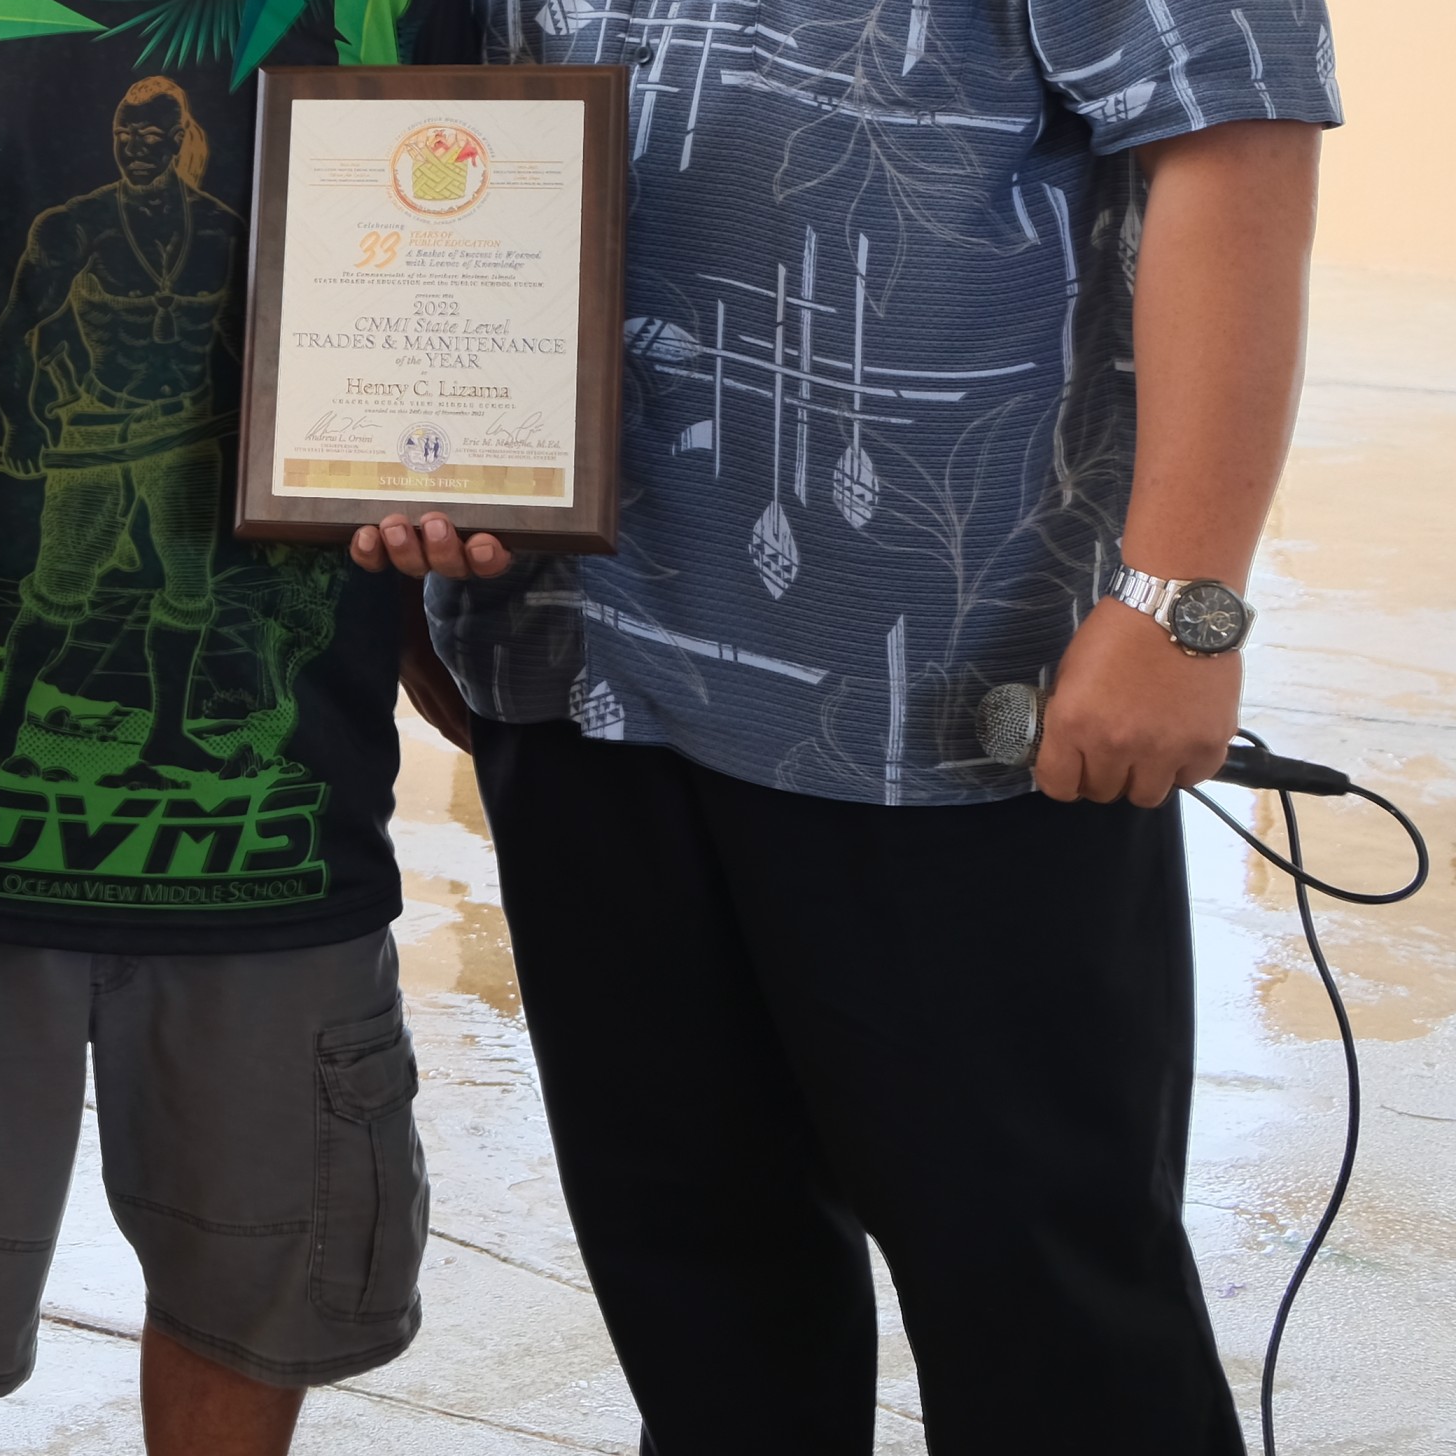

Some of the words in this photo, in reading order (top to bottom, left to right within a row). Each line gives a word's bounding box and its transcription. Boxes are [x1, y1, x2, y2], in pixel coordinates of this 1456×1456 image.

[357, 221, 406, 231] Celebrating
[408, 238, 442, 247] PUBLIC
[441, 239, 501, 248] EDUCATION
[409, 231, 440, 239] YEARS
[441, 231, 454, 239] OF
[353, 230, 402, 269] 33
[413, 300, 461, 316] 2022
[354, 316, 410, 333] CNMI
[414, 318, 459, 334] State
[462, 318, 511, 336] Level
[292, 332, 376, 349] TRADES
[381, 334, 397, 350] &
[395, 355, 407, 366] of
[407, 355, 422, 366] the
[425, 352, 482, 369] YEAR
[345, 377, 409, 401] Henry
[413, 380, 434, 397] C.
[438, 380, 512, 400] Lizama
[378, 475, 436, 488] STUDENTS
[438, 478, 470, 489] FIRST
[2, 874, 79, 899] OCEAN
[82, 880, 138, 902] VIEW
[141, 883, 224, 904] MIDDLE
[227, 878, 307, 901] SCHOOL
